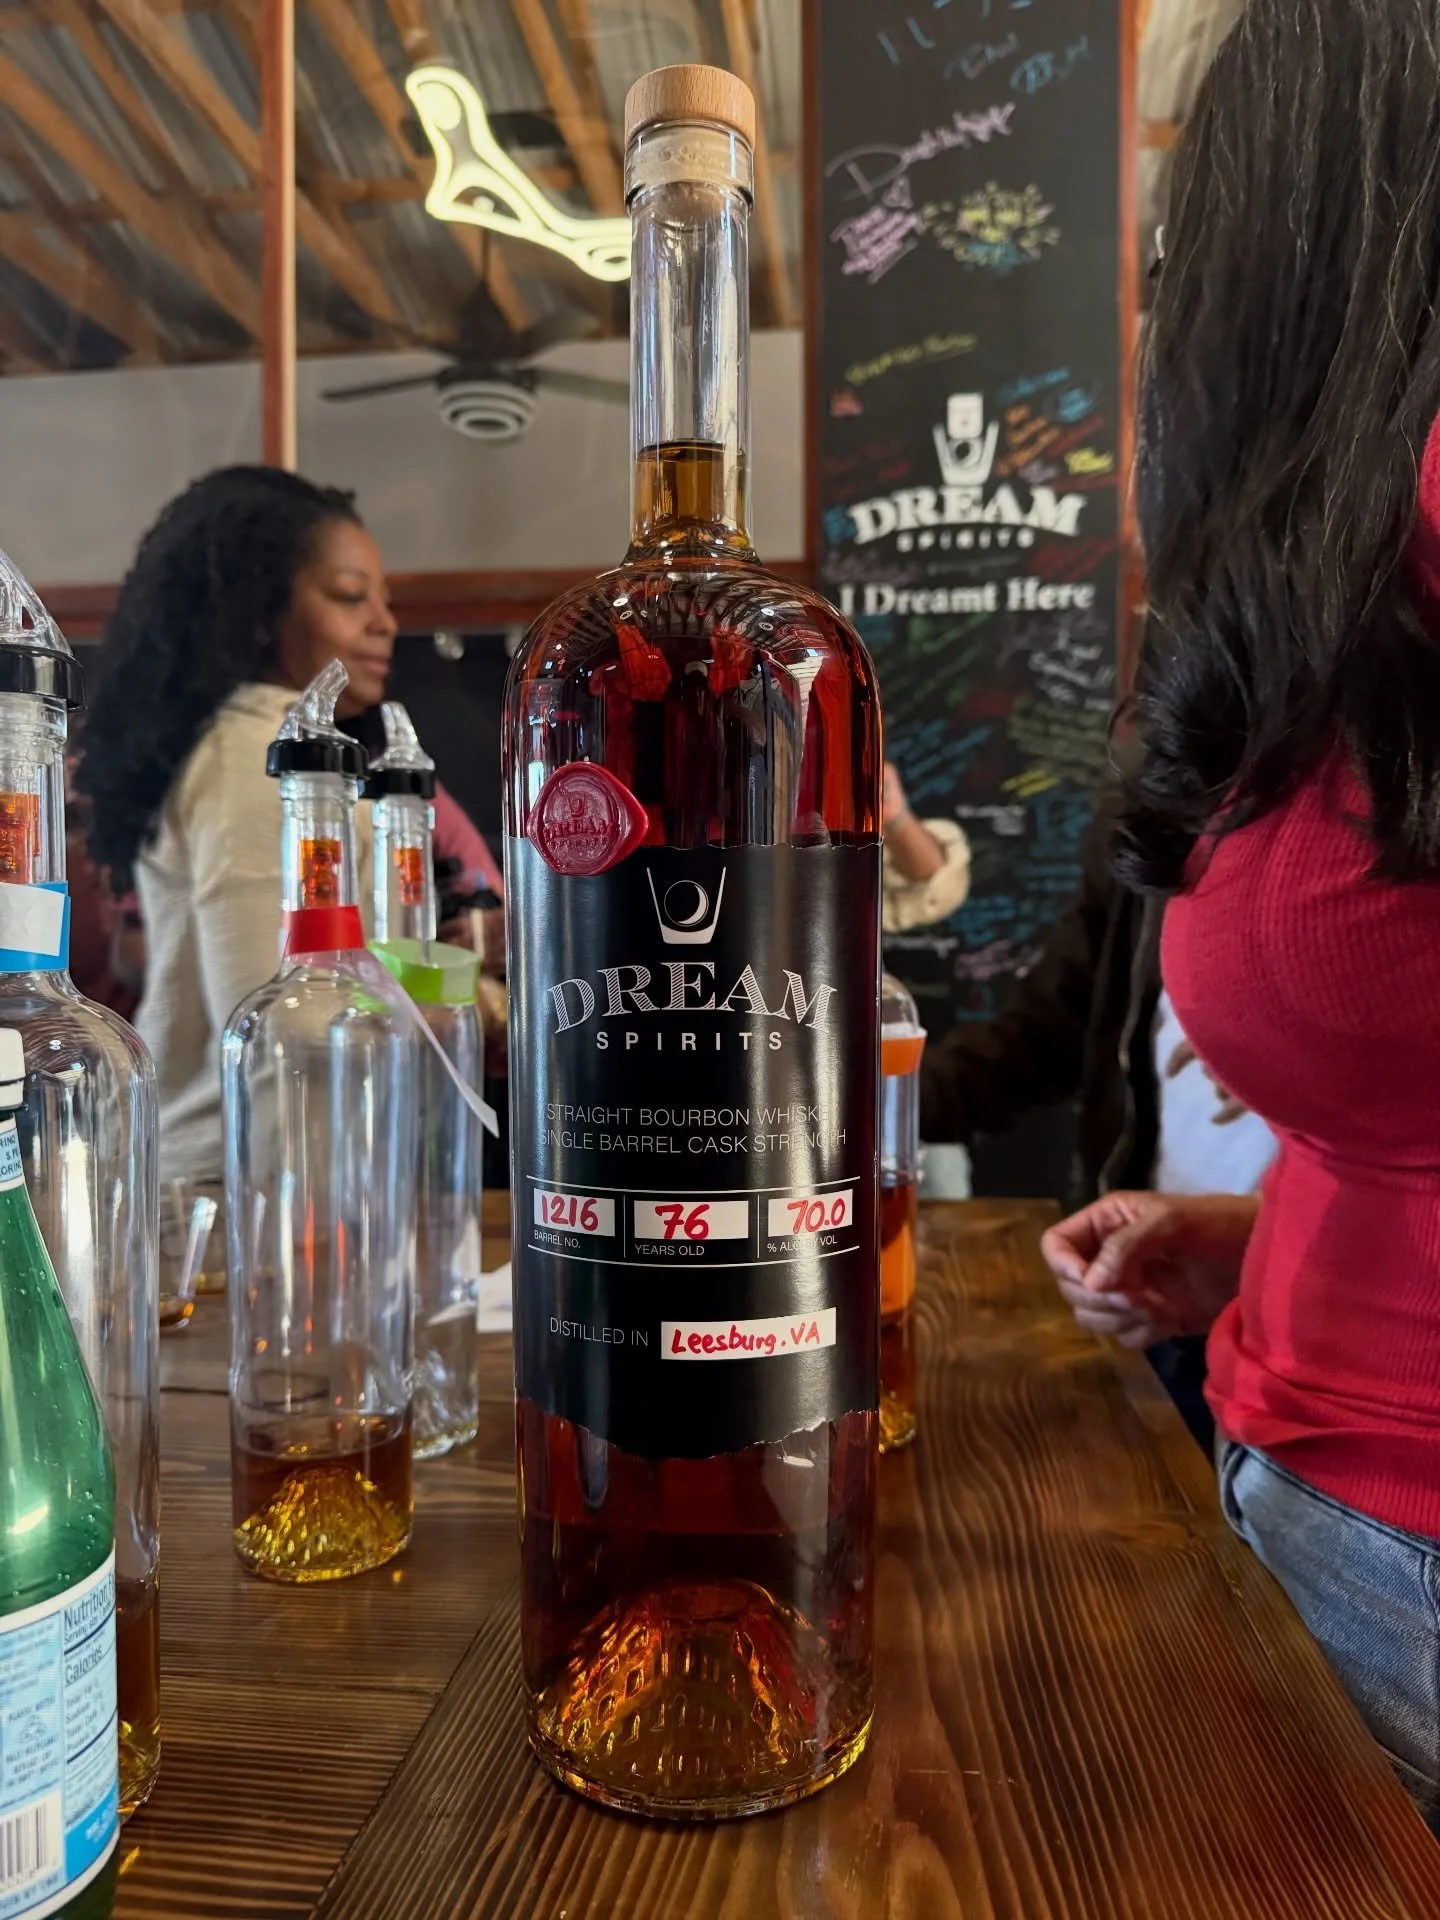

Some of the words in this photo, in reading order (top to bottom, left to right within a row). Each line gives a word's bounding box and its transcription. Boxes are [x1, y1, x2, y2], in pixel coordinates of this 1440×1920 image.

[848, 485, 1087, 544] DREAM
[863, 582, 998, 615] Dreamt
[1006, 576, 1095, 611] Here
[547, 961, 838, 1033] DREAM
[596, 1031, 782, 1050] SPIRITS
[547, 1103, 632, 1125] STRAIGHT
[640, 1108, 750, 1127] BOURBON
[756, 1104, 838, 1125] WHISKE
[541, 1128, 594, 1150] SINGLE
[600, 1134, 681, 1154] BARREL
[688, 1135, 748, 1154] CASK
[541, 1194, 599, 1231] 1216
[655, 1203, 710, 1240] 76
[787, 1197, 846, 1234] 70.0
[534, 1229, 562, 1246] BARREL
[564, 1237, 581, 1249] NO.
[634, 1244, 675, 1256] YEARS
[678, 1245, 705, 1256] OLD
[767, 1242, 777, 1252] %
[820, 1234, 838, 1246] VOL
[550, 1317, 625, 1344] DISTILLED
[631, 1330, 648, 1347] IN
[64, 1585, 107, 1631] Nutrition
[65, 1644, 102, 1685] Calories
